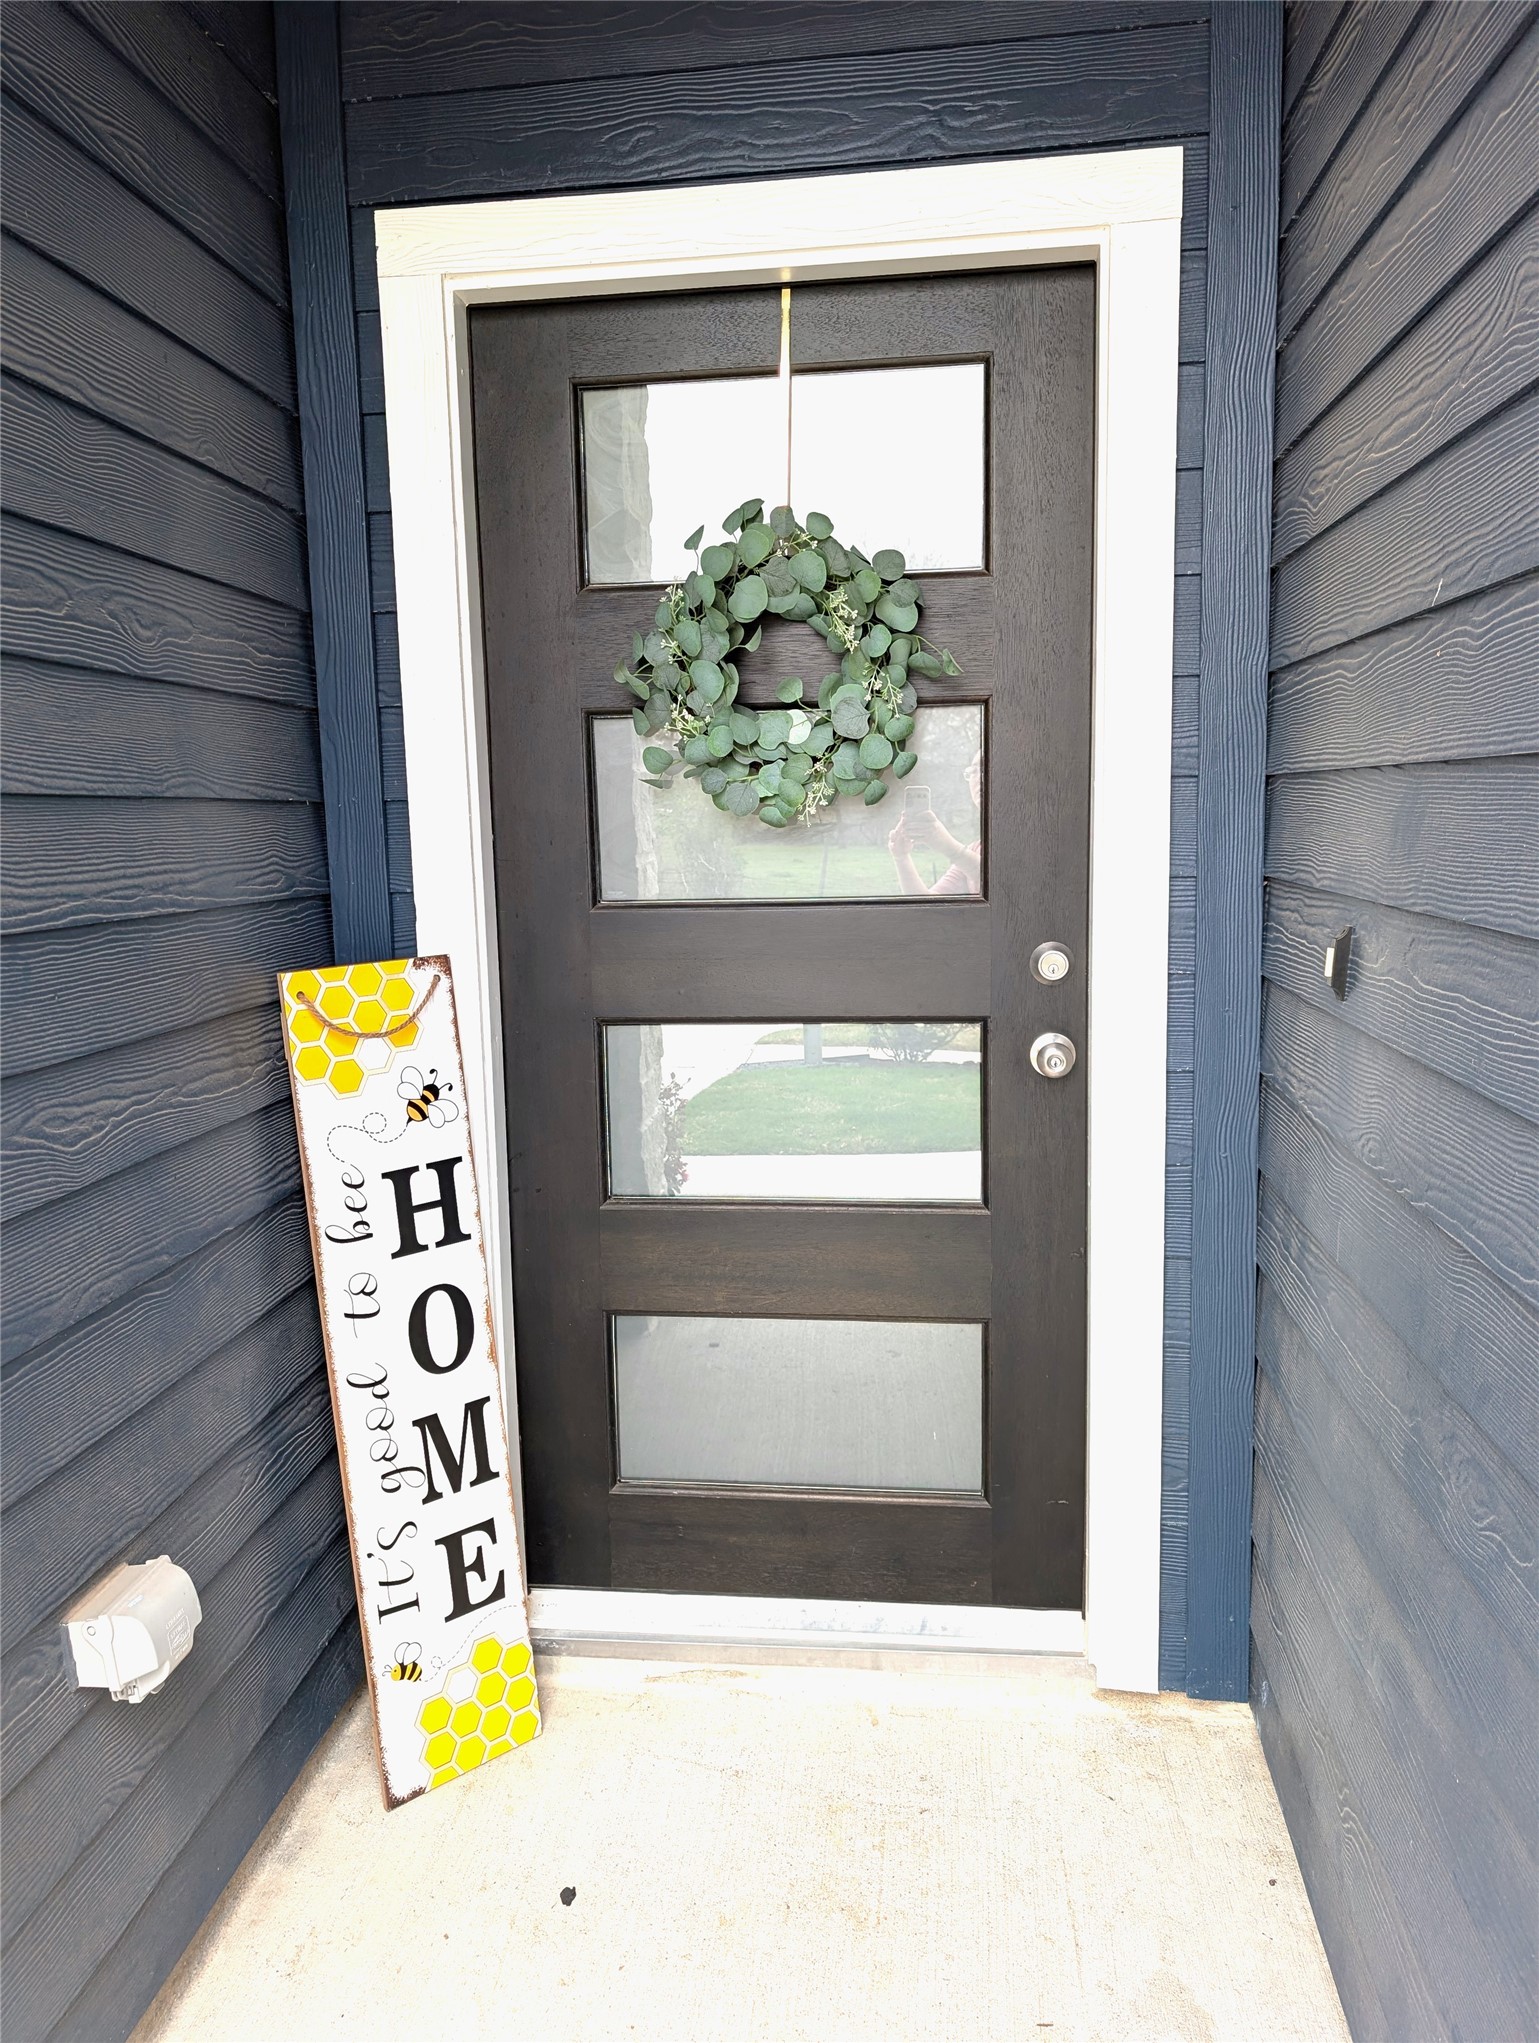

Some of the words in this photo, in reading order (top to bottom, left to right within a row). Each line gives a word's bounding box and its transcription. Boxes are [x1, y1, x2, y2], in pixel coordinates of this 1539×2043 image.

[324, 1163, 374, 1244] bee
[343, 1272, 381, 1339] to
[346, 1362, 426, 1494] good
[381, 1156, 506, 1624] HOME
